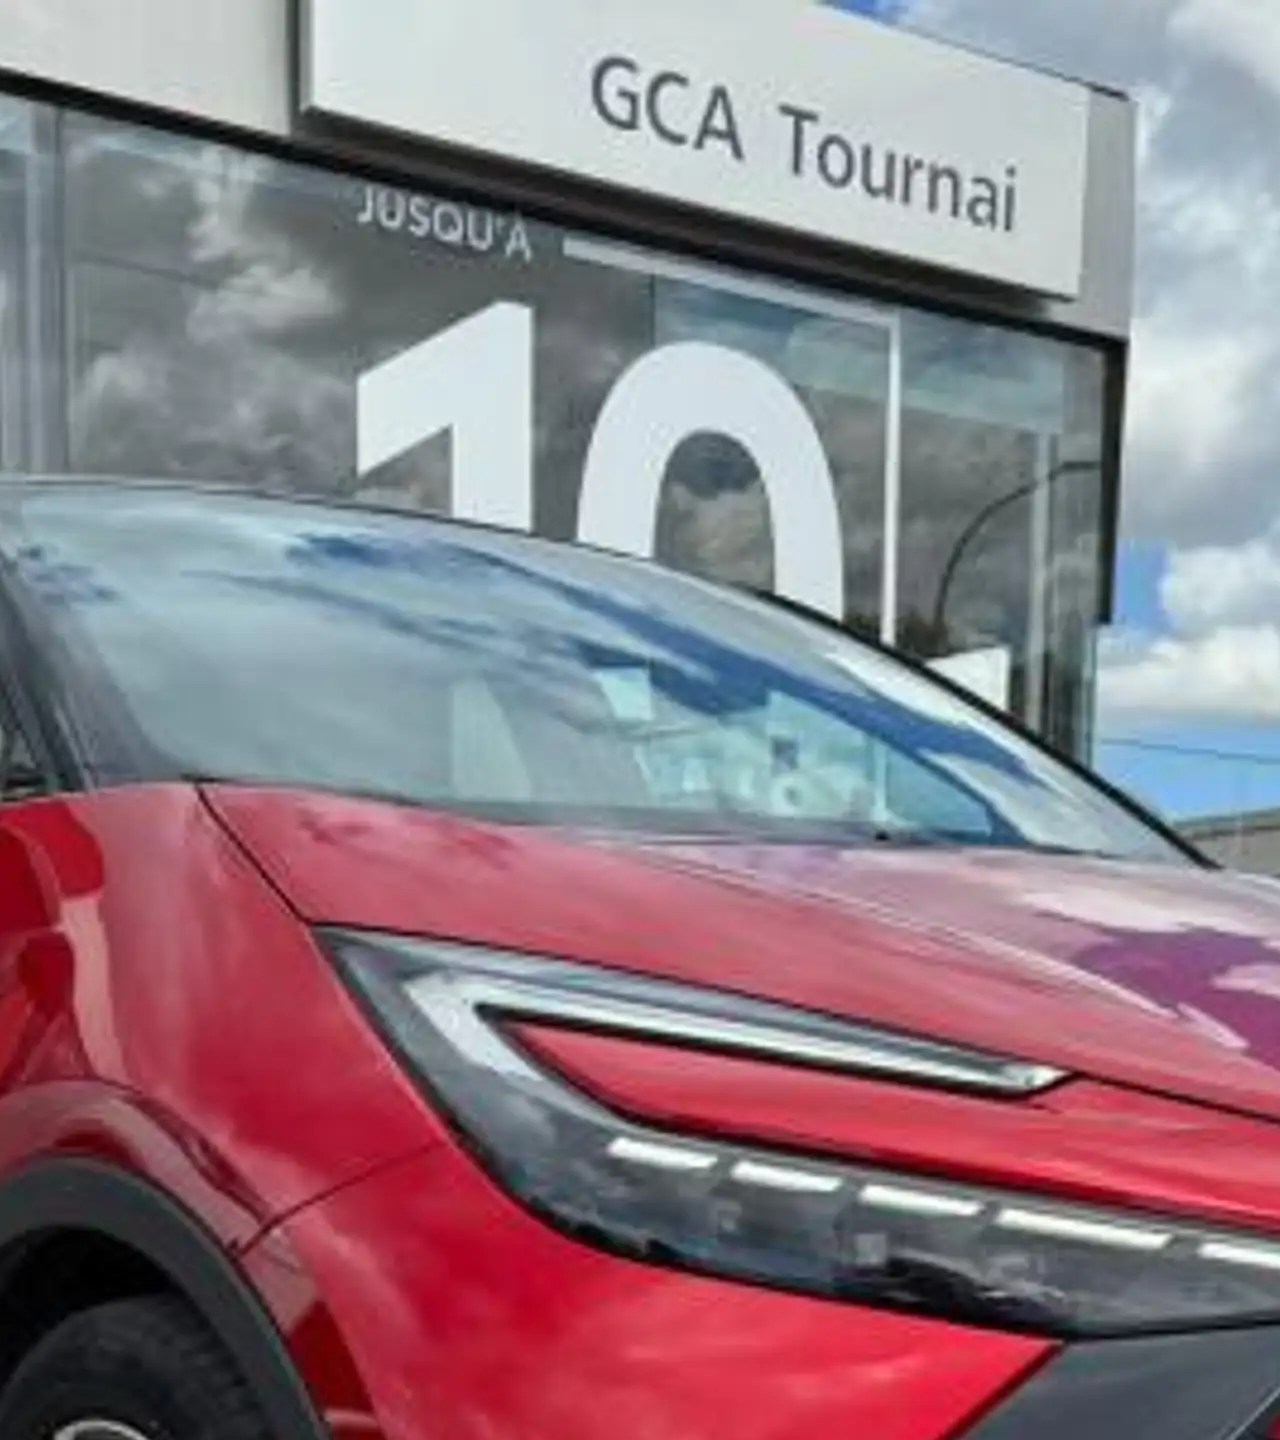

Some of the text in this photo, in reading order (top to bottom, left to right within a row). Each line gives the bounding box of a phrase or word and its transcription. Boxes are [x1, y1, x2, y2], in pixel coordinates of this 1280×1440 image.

[590, 56, 1017, 233] GCA Tournai
[357, 300, 844, 626] 10
